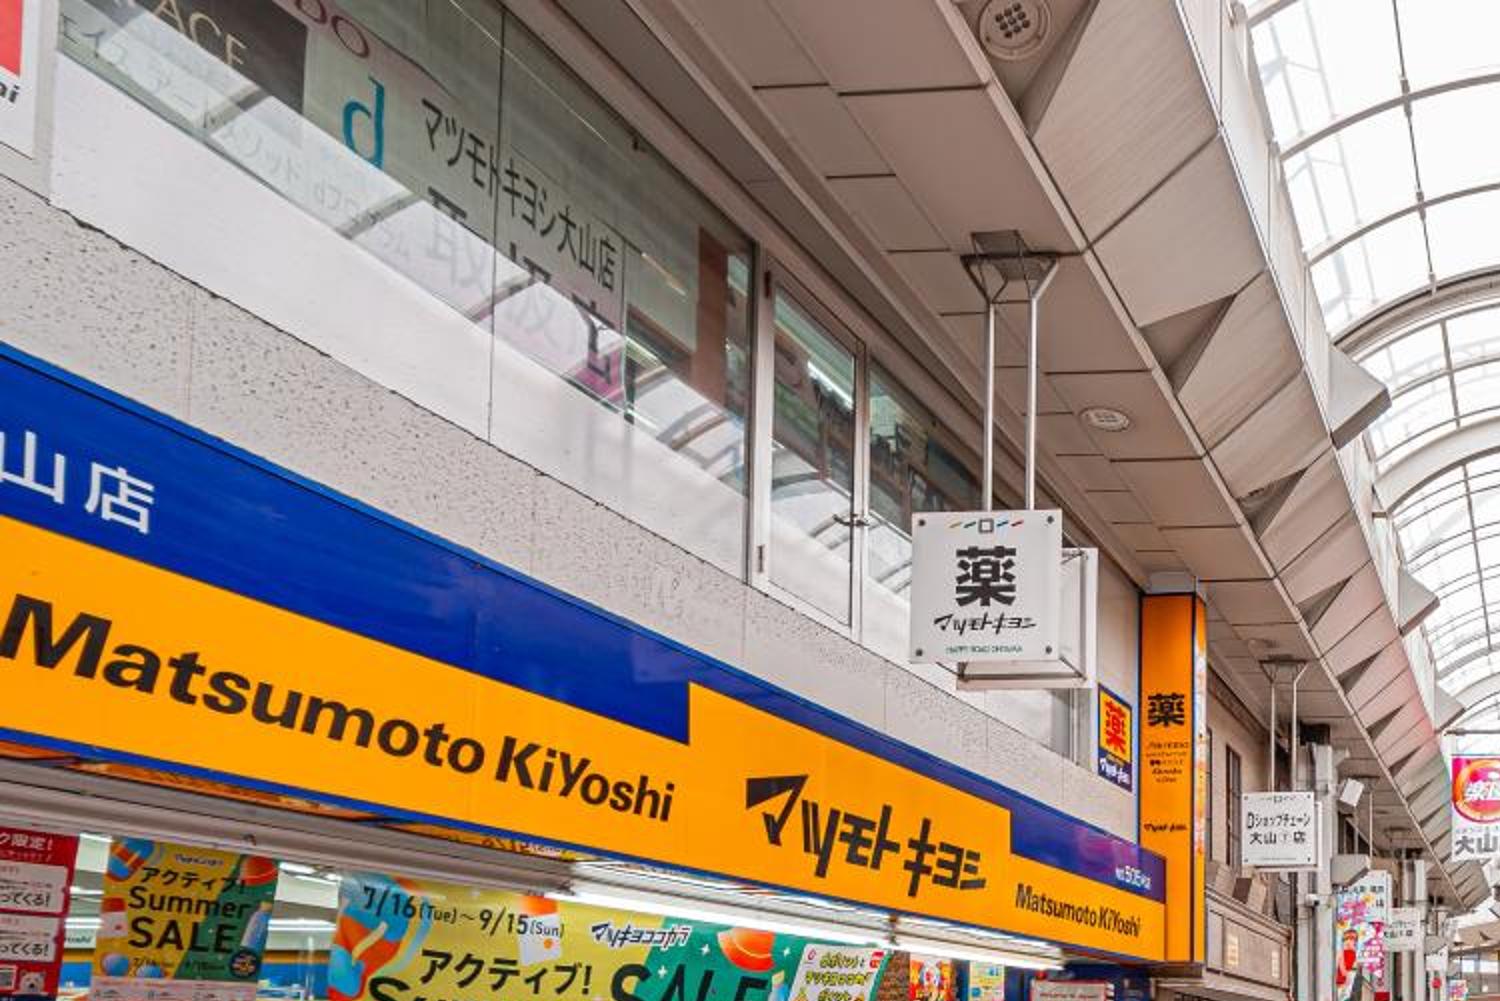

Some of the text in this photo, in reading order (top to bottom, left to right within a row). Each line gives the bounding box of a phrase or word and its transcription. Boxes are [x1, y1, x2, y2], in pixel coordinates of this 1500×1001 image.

[421, 98, 616, 292] マツモトキヨシ大山店
[955, 545, 1017, 607] 薬
[934, 612, 1036, 636] マツモトキヨシ
[0, 594, 675, 823] Matsumoto KiYoshi
[1147, 692, 1185, 727] 薬
[746, 775, 986, 897] マツモトキヨシ
[143, 866, 246, 893] アクティブ!
[127, 886, 252, 919] Summer
[1015, 882, 1141, 938] Matsumoto KiYoshi
[128, 917, 236, 954] SALE
[591, 922, 692, 948] マツキヨココカラ
[421, 949, 592, 995] アクティブ!
